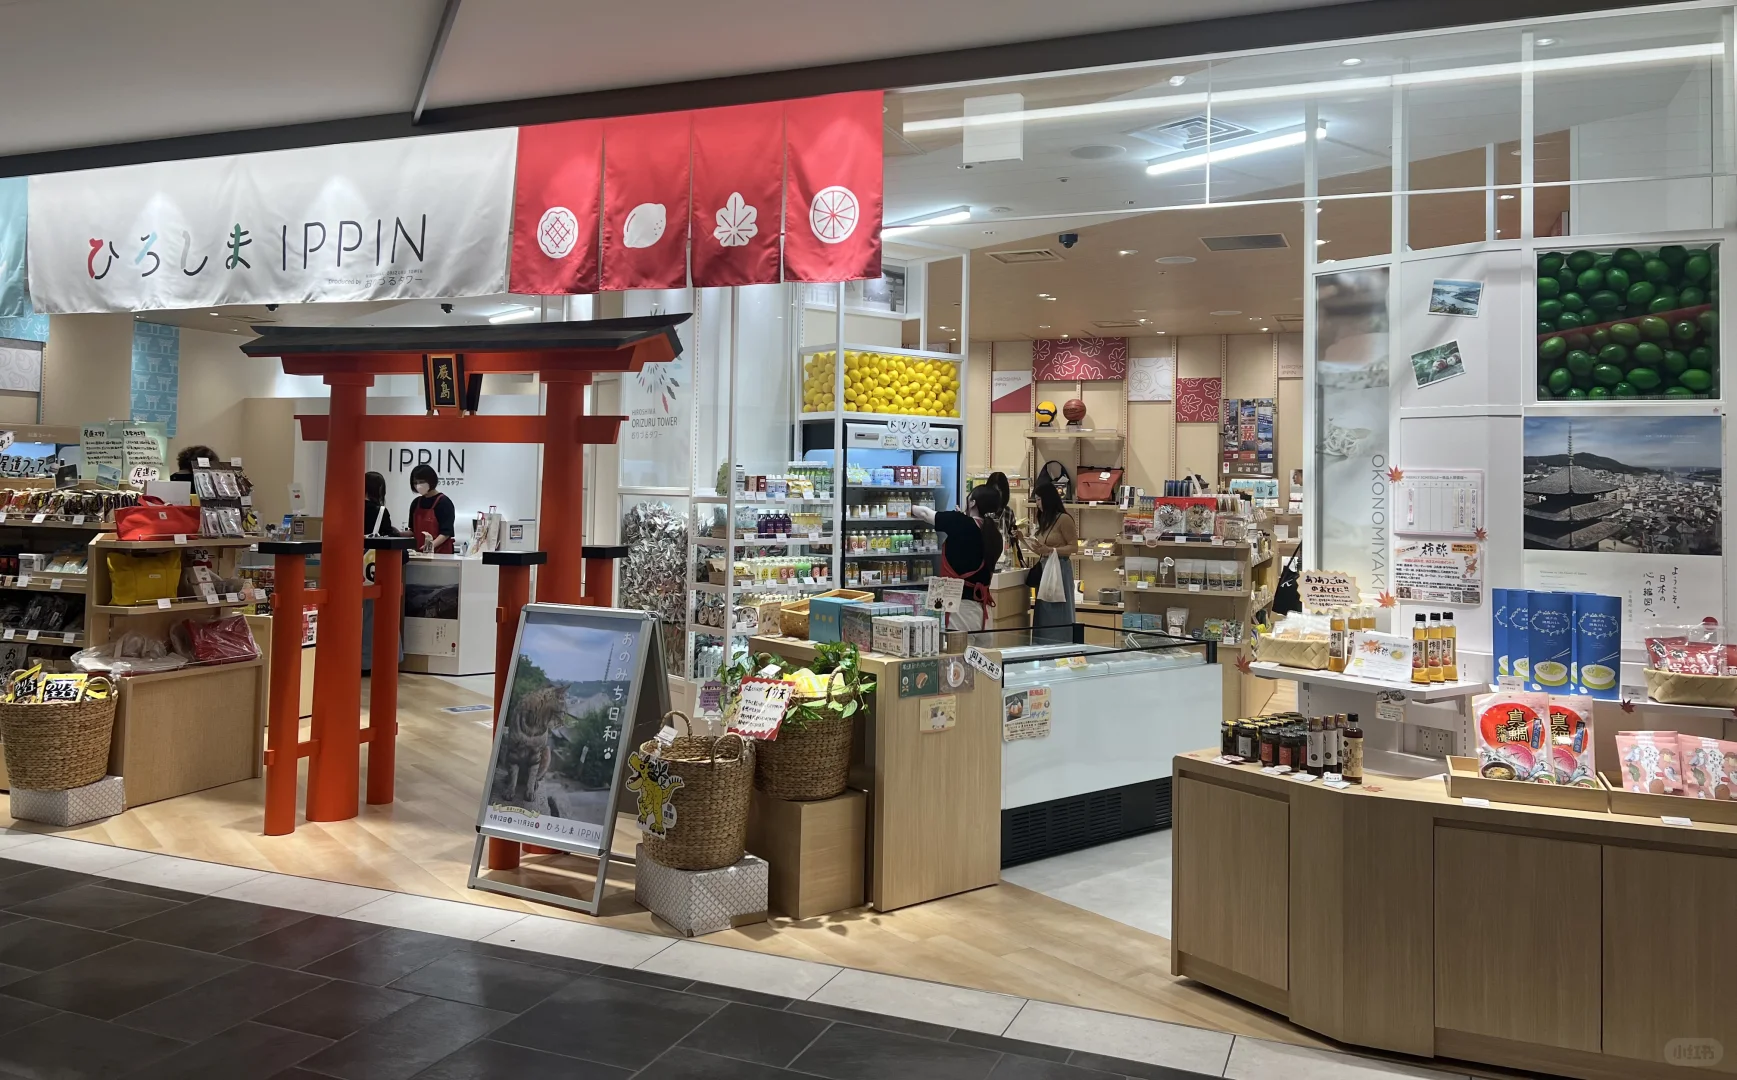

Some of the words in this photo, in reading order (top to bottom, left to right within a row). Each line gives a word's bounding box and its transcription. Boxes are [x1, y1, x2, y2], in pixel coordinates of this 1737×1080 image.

[88, 222, 253, 280] ひろしま
[281, 213, 427, 271] IPPIN
[631, 408, 656, 416] HIROSHIMA
[631, 417, 656, 428] ORIZURU
[657, 416, 678, 427] TOWER
[890, 420, 927, 431] ドリンク
[903, 434, 949, 446] 冷えてます
[133, 466, 157, 478] 尾道は
[388, 448, 465, 474] IPPIN
[1371, 454, 1385, 590] OKONOMIYAKI
[1305, 575, 1350, 585] あつあつごはん
[1657, 574, 1667, 602] 日本の
[1671, 566, 1681, 610] ようこそ。
[602, 631, 636, 742] おのみち日和
[1507, 708, 1530, 743] 真鯛
[546, 822, 574, 836] ひろしま
[577, 827, 601, 841] IPPIN
